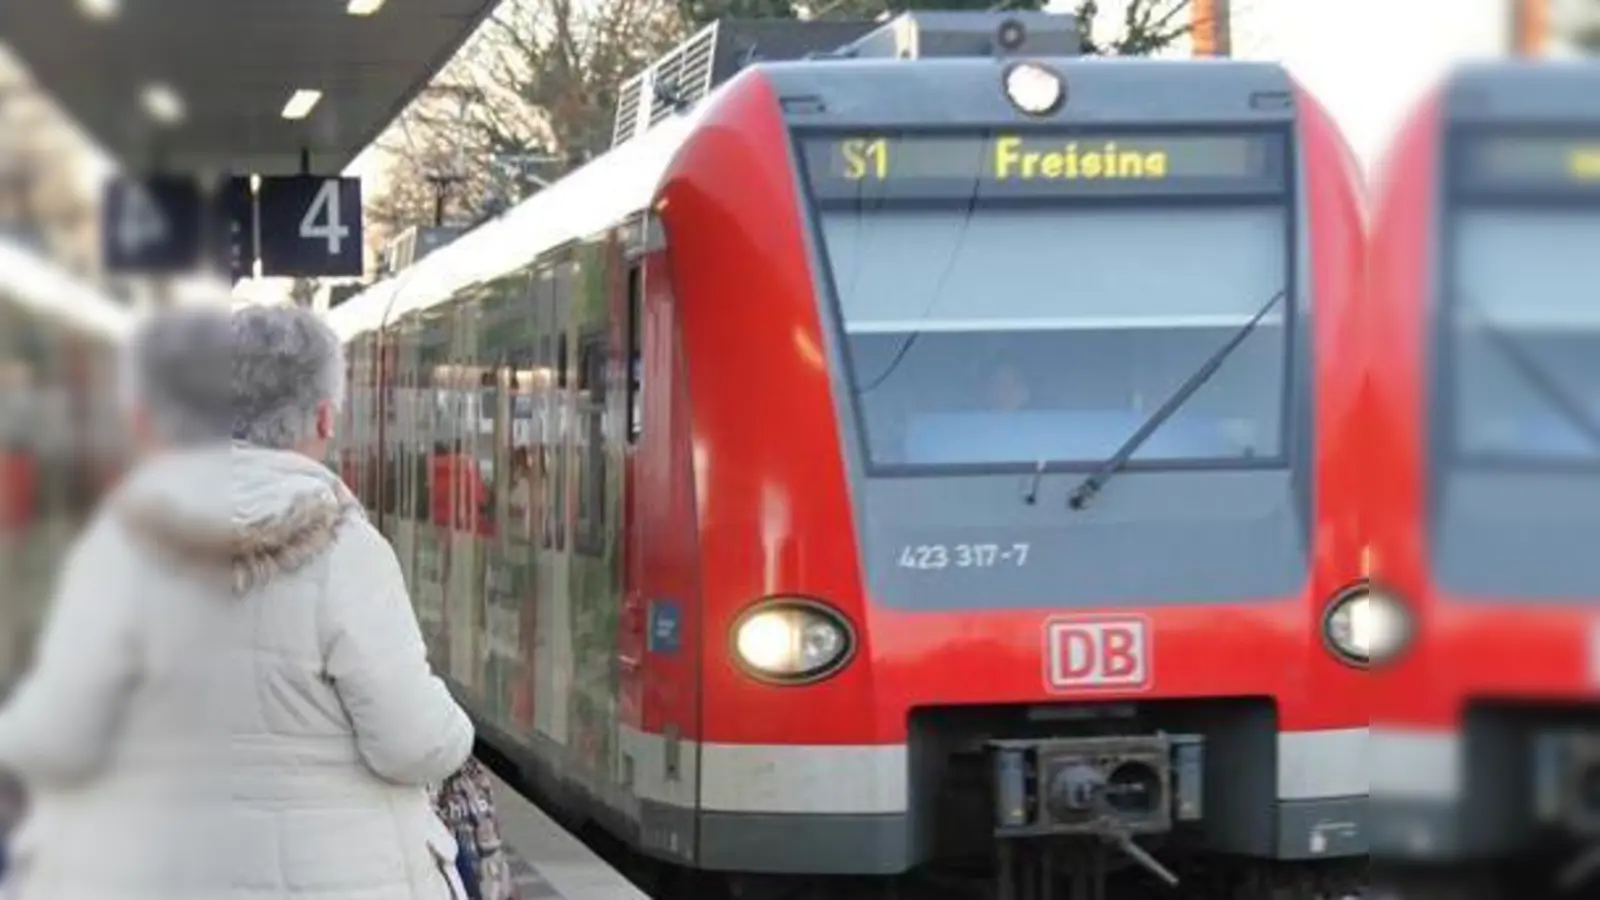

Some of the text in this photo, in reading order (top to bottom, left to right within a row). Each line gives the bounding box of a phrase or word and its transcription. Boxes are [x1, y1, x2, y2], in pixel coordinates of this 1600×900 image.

[841, 138, 887, 180] S1
[298, 178, 350, 255] 4
[898, 543, 1031, 570] 423 317-7
[1057, 626, 1139, 680] DB
